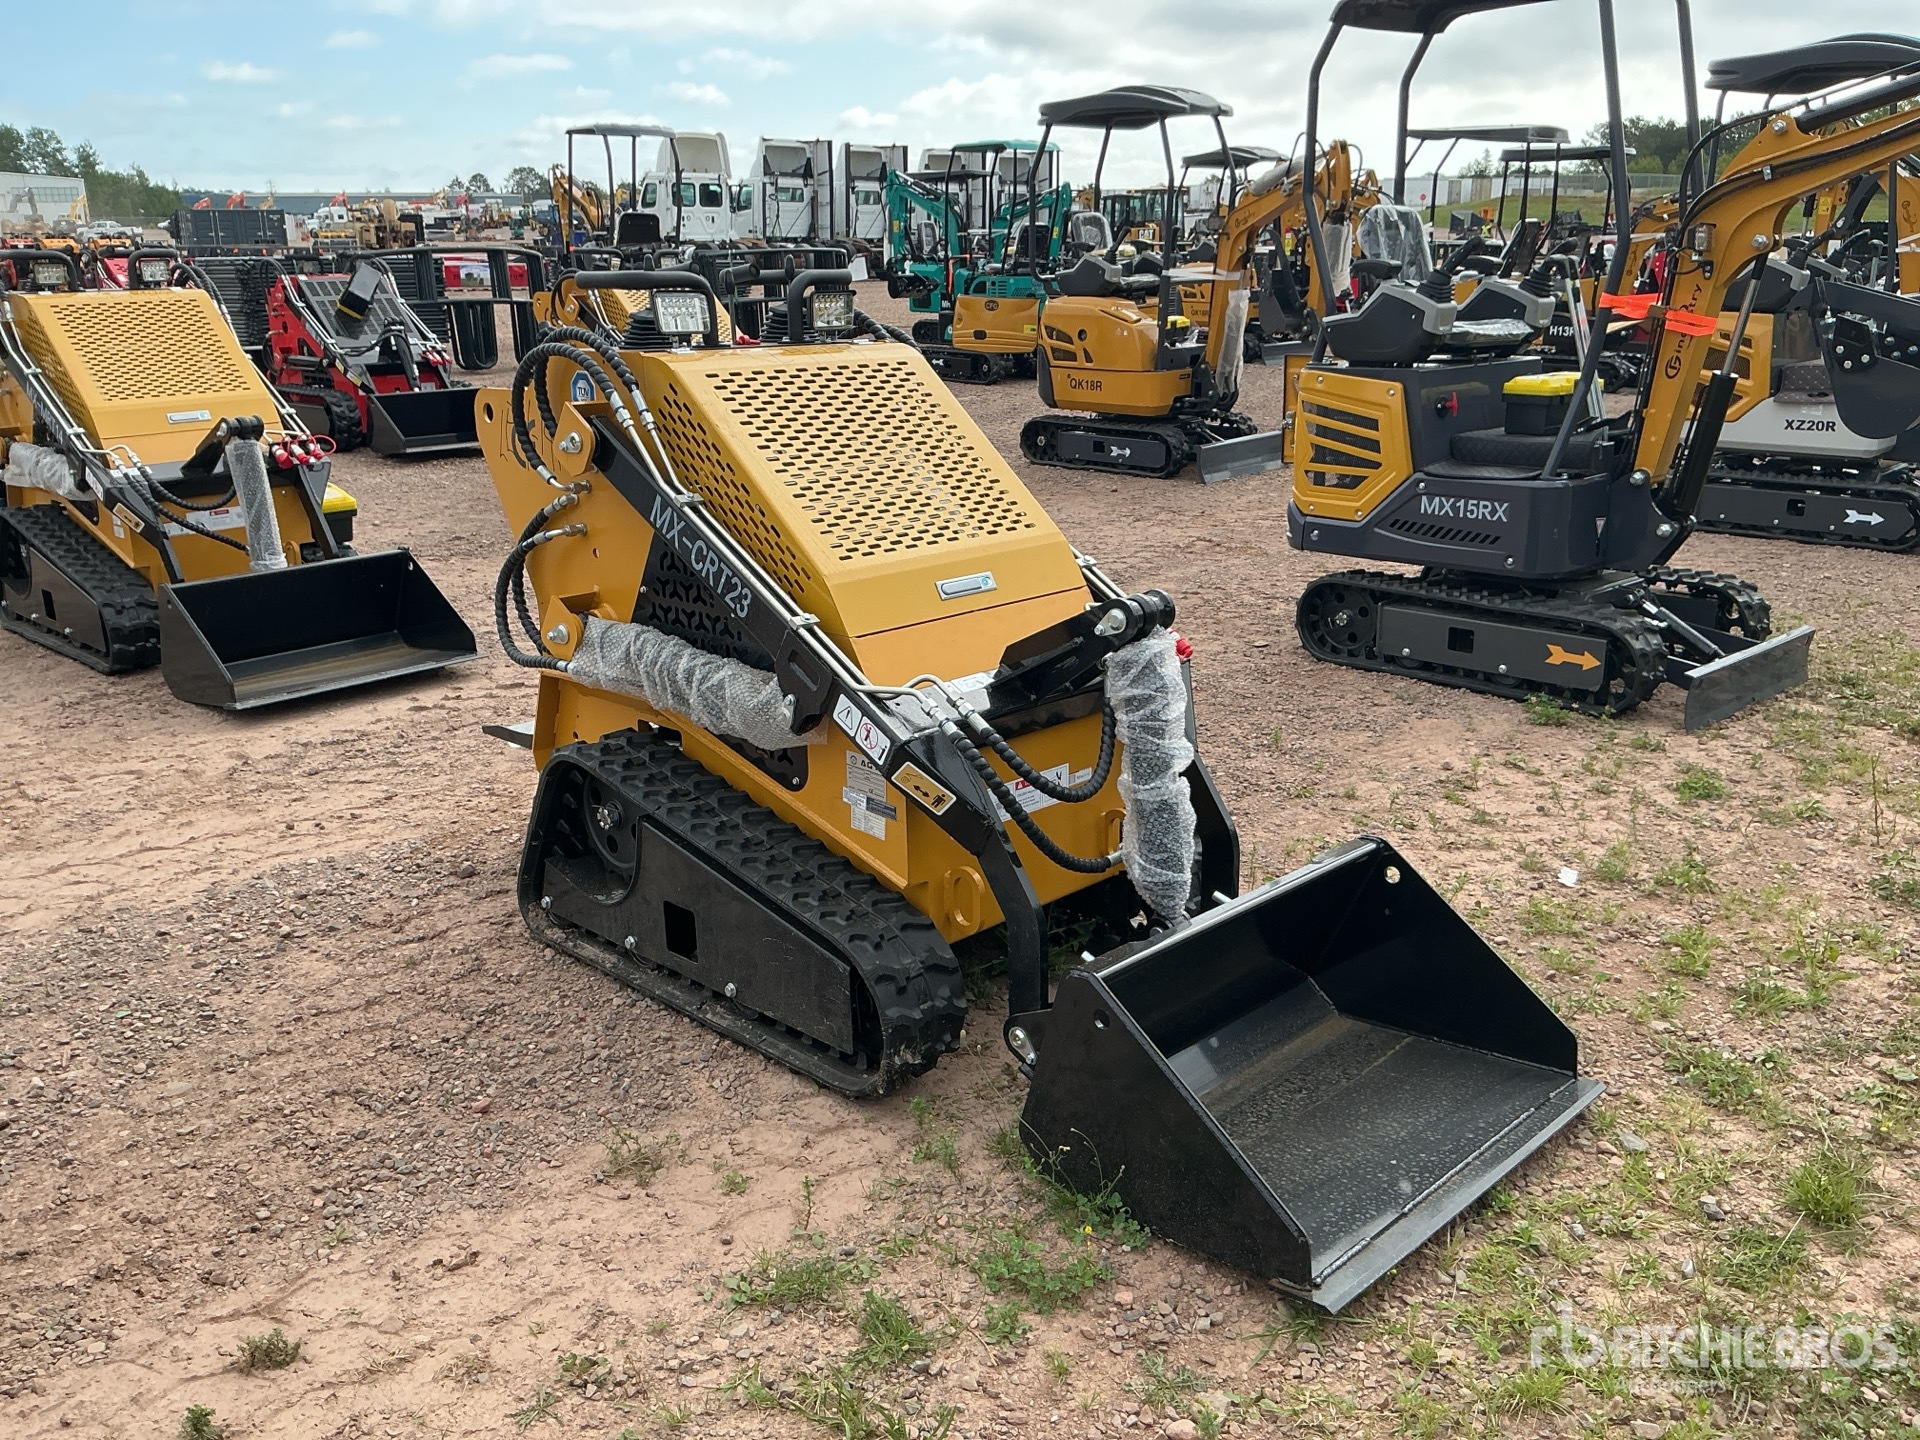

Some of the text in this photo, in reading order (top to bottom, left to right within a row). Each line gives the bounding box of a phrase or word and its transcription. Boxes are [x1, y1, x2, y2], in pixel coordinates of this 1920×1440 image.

[1138, 229, 1154, 241] CAT
[1069, 377, 1103, 392] QK18R
[1783, 418, 1837, 433] XZ20R
[1420, 494, 1510, 523] MX15RX
[648, 493, 752, 619] MX-CRT23
